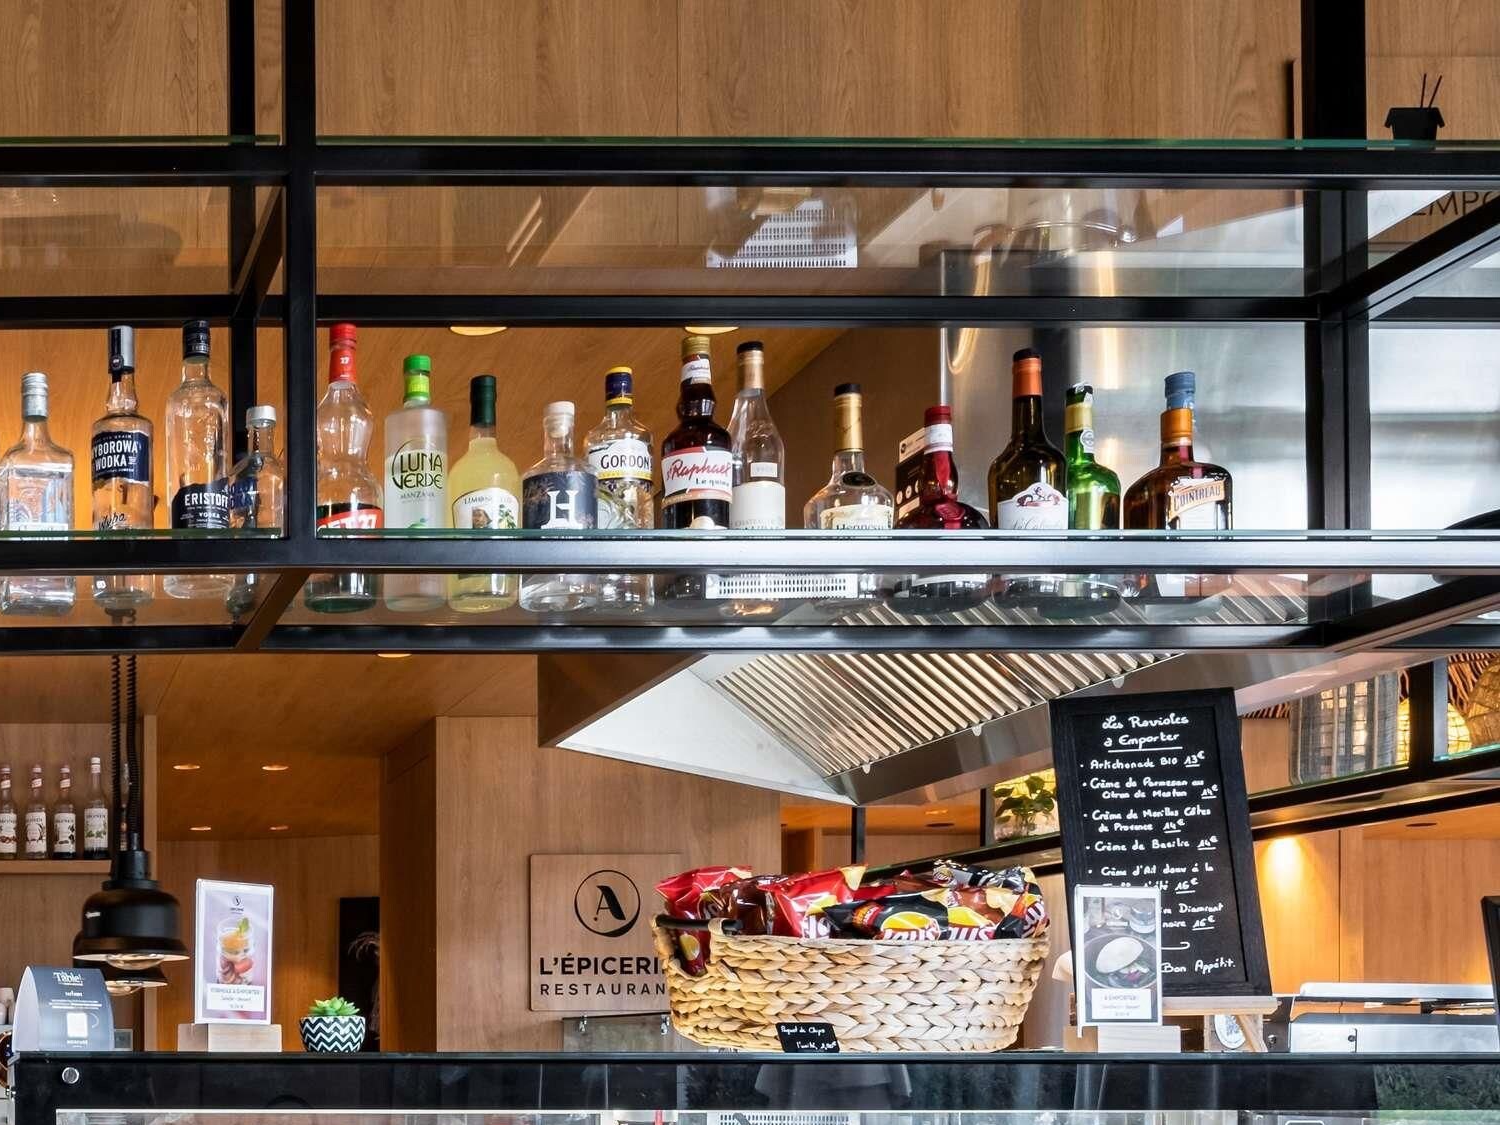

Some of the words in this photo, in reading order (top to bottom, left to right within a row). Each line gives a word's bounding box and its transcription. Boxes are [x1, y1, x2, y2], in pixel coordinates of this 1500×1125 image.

[1411, 190, 1500, 217] MP
[399, 451, 443, 474] LUNA
[600, 453, 653, 470] GORDON
[392, 473, 443, 490] VERDE
[1172, 487, 1222, 512] COINTREAU
[1102, 714, 1124, 730] Les
[1118, 732, 1181, 750] Emporter
[539, 952, 666, 976] L'ÉPICERI
[539, 982, 666, 996] RESTAURAN
